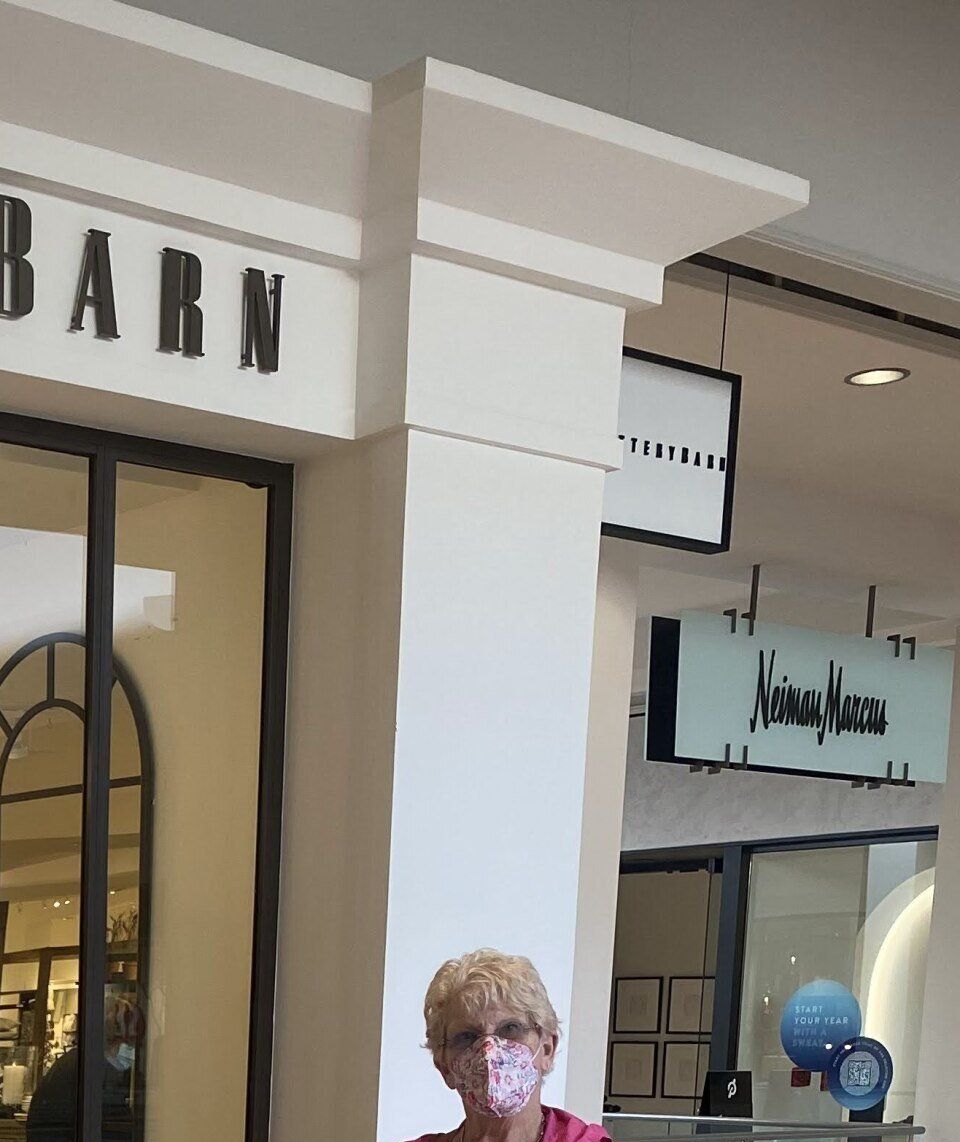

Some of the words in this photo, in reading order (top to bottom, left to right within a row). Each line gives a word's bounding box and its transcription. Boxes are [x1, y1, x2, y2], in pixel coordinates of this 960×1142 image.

[750, 649, 822, 733] Neiman
[817, 660, 889, 746] Marcus
[795, 1005, 823, 1014] START
[794, 1016, 820, 1025] YOUR
[825, 1016, 849, 1025] YEAR
